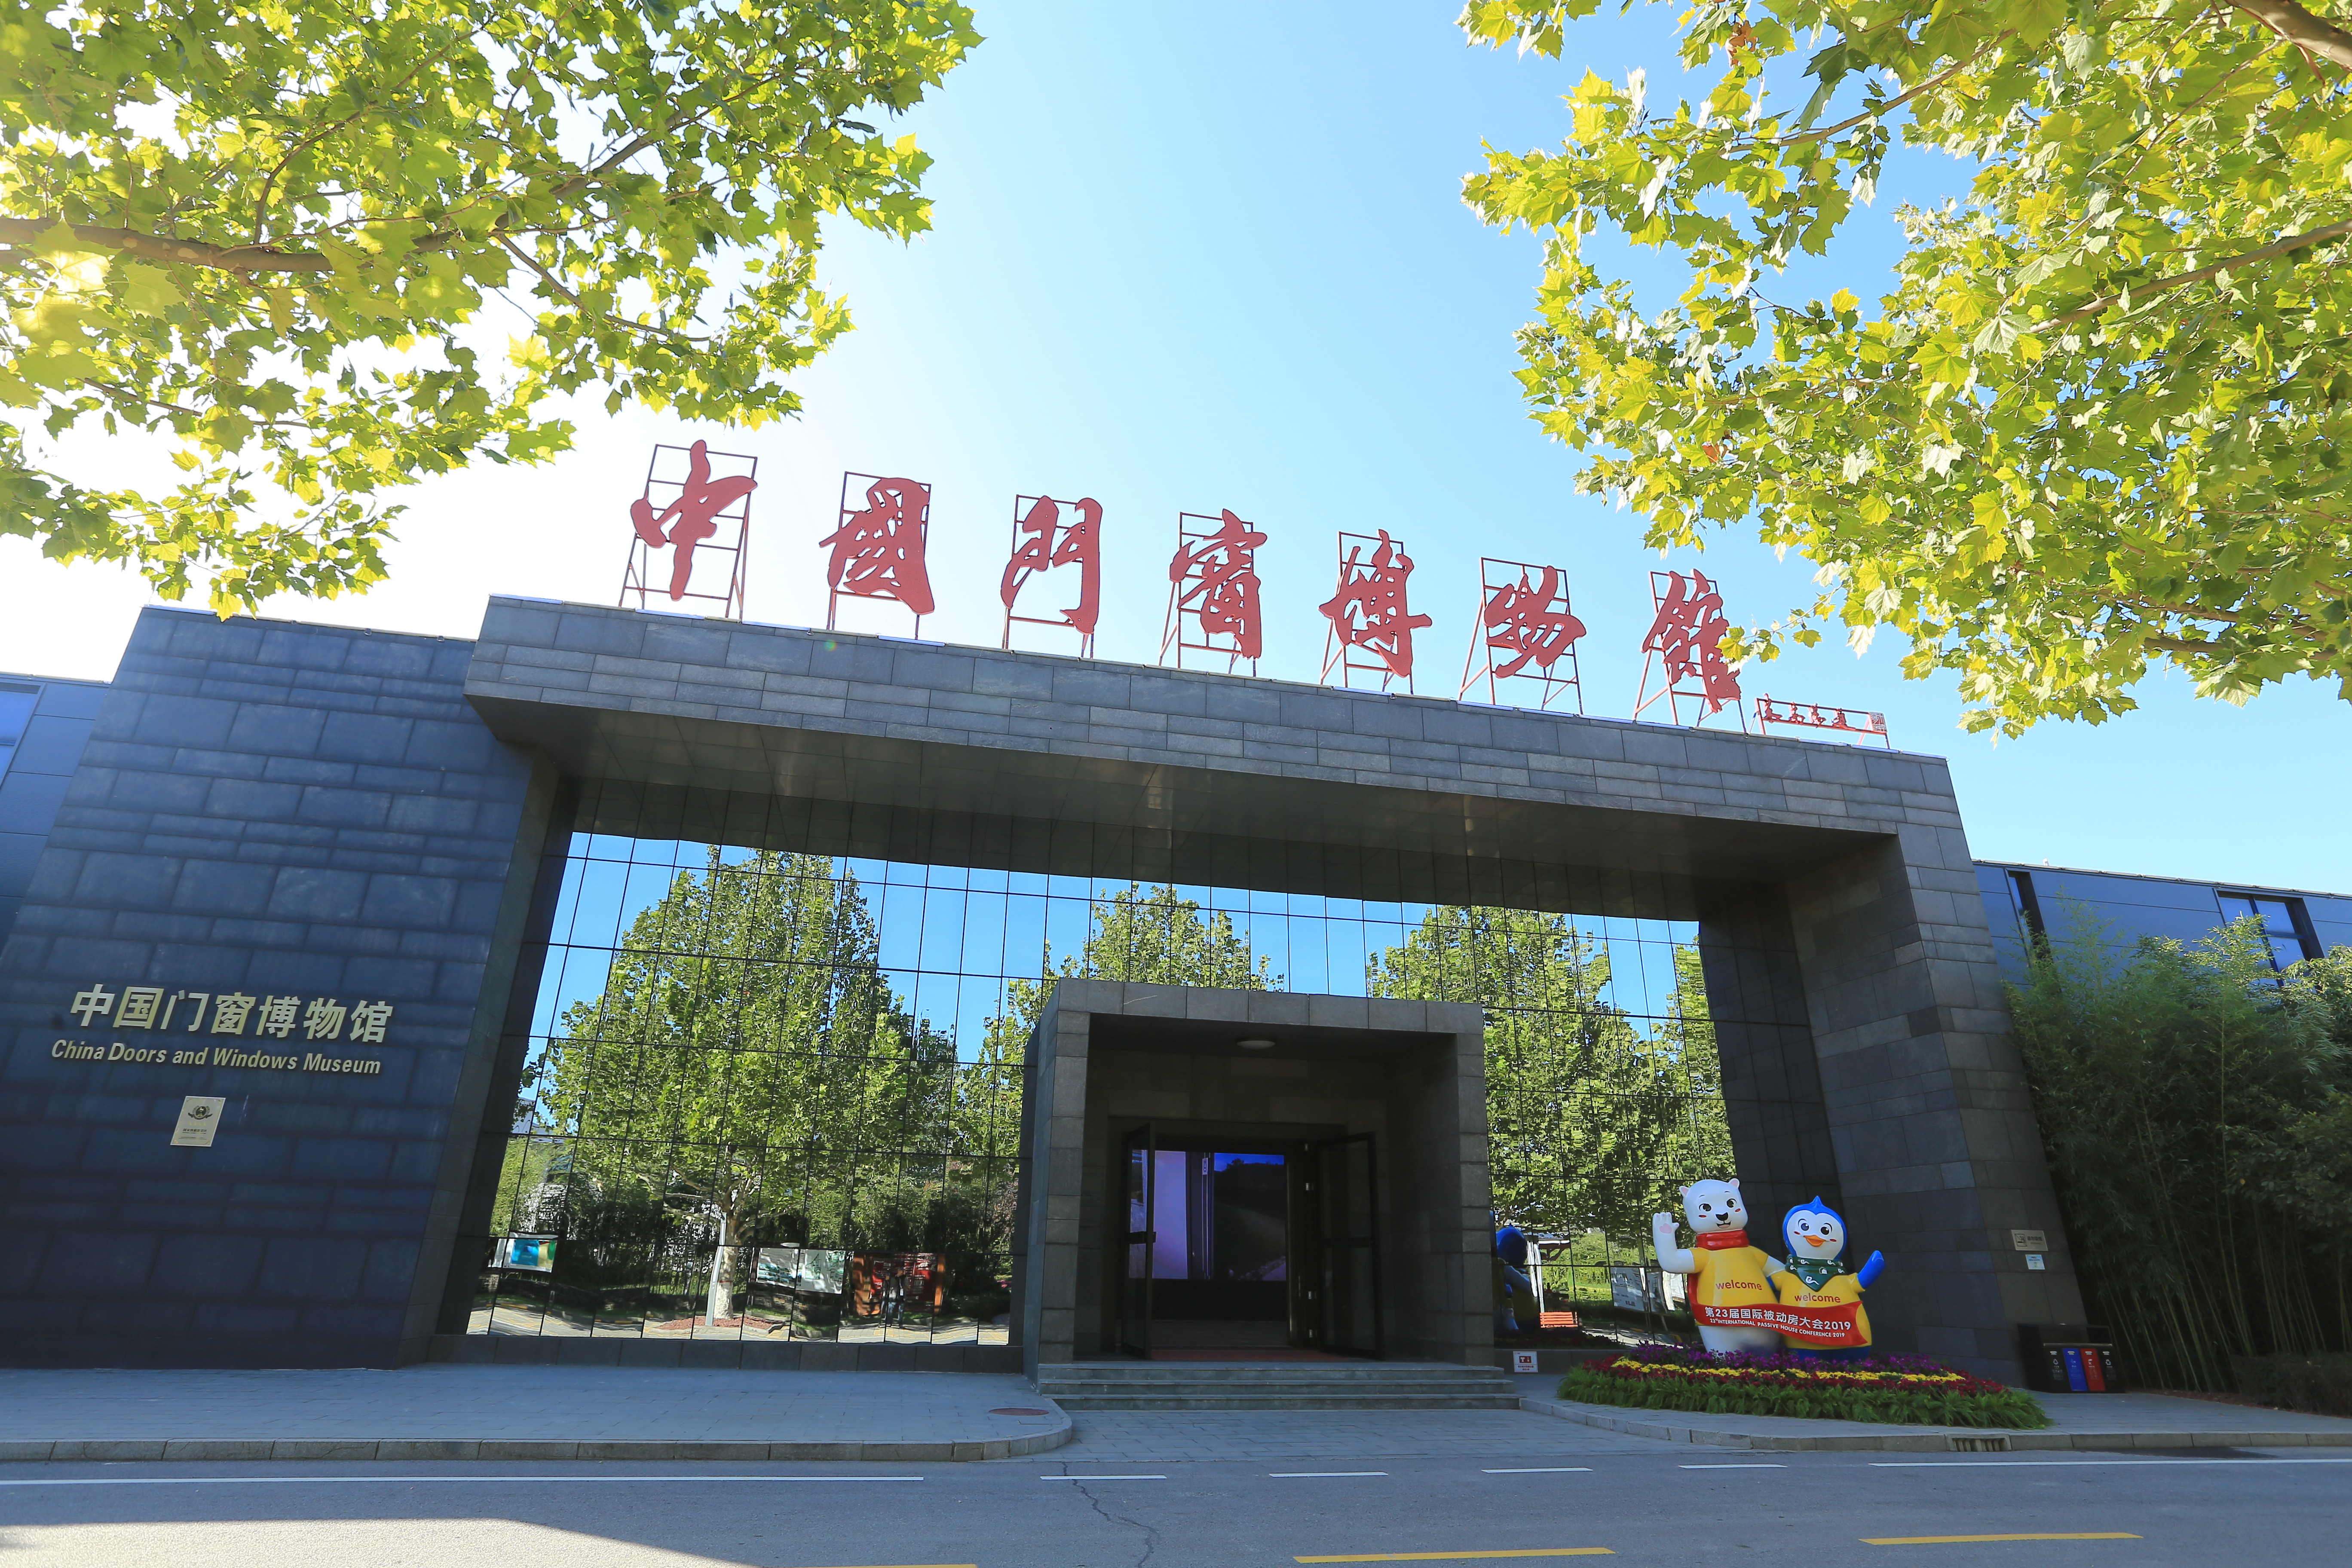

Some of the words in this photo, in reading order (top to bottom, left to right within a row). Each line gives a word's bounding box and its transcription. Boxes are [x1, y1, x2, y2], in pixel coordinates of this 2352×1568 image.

[70, 984, 393, 1043] 中国门窗博物馆
[51, 1039, 104, 1061] China
[108, 1042, 167, 1063] Doors
[172, 1047, 207, 1065] and
[213, 1047, 297, 1069] Windows
[303, 1053, 381, 1074] Museum
[1716, 1280, 1762, 1290] welcome
[1795, 1293, 1841, 1303] welcome
[1705, 1306, 1851, 1331] 第23届国际被动房大会2019
[1780, 1325, 1798, 1333] HOUSE
[1799, 1329, 1832, 1337] CONFERENCE
